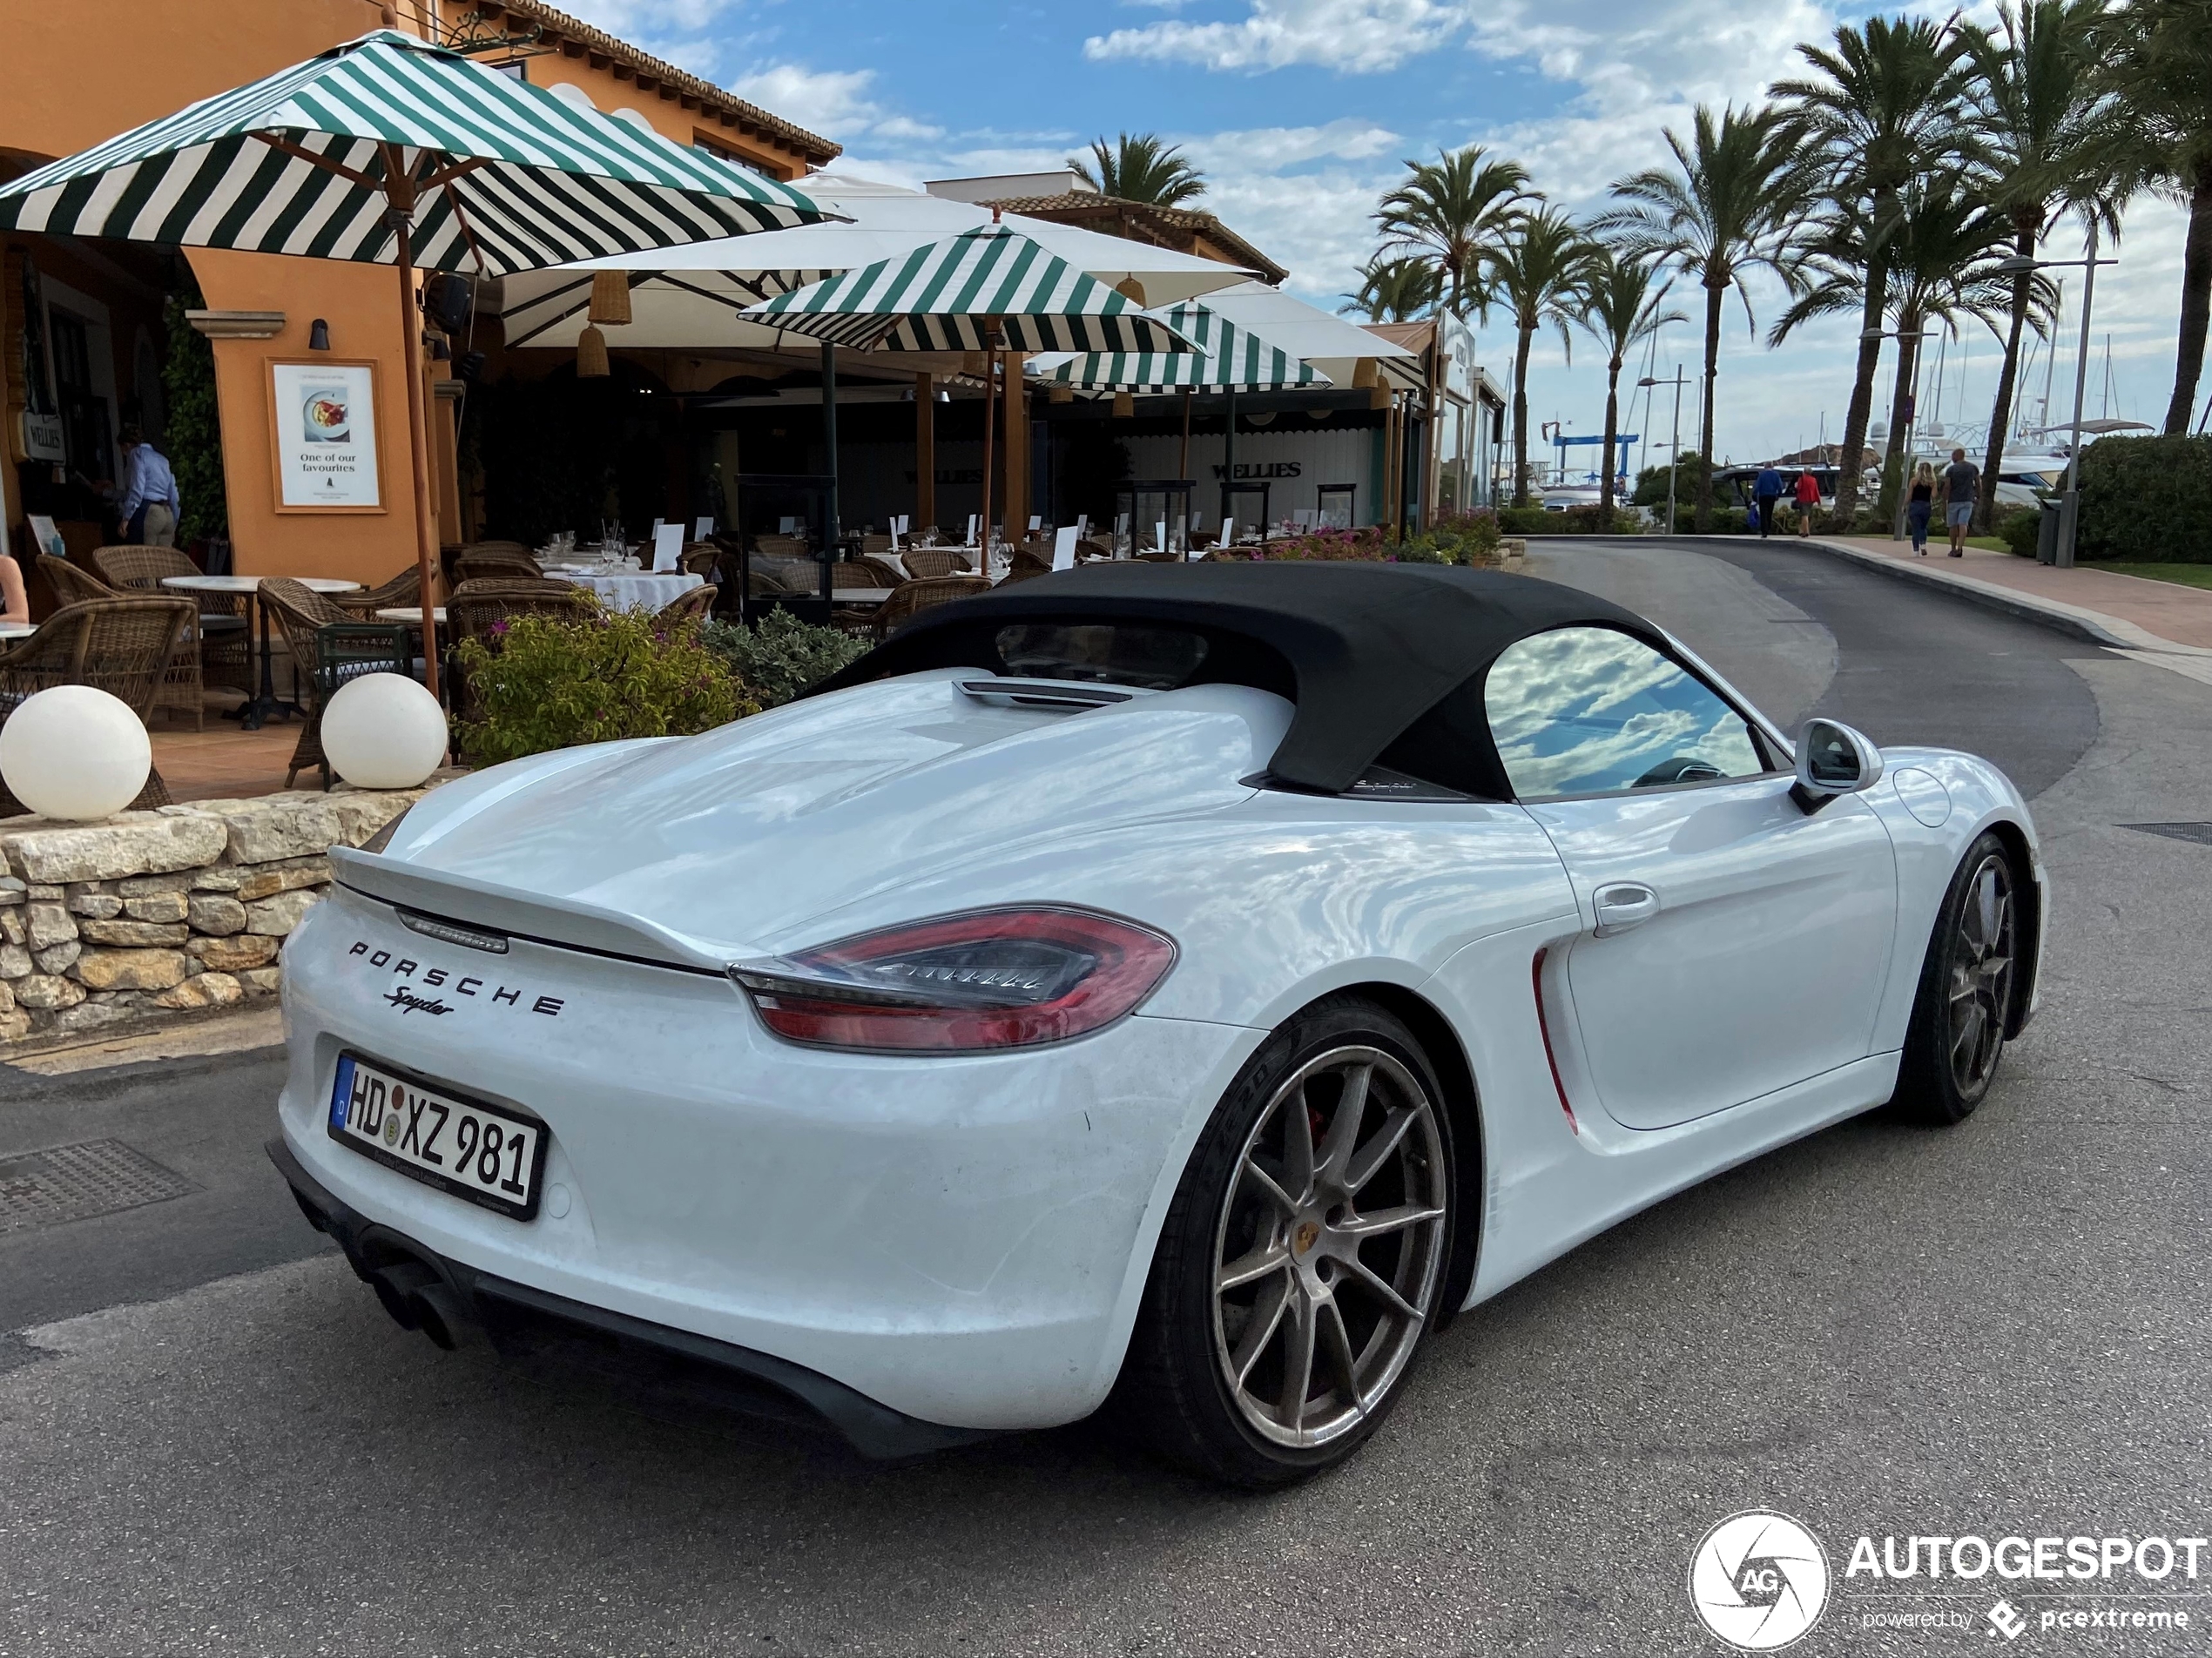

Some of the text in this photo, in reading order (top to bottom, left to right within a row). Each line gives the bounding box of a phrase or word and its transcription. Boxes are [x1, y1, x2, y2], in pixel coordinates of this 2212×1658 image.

[30, 425, 60, 448] WELLIES
[300, 453, 356, 462] One of our
[302, 463, 355, 473] favourites
[1211, 462, 1302, 480] WELLIES
[349, 940, 565, 1016] PORSCHE
[383, 986, 455, 1014] Spyder
[347, 1070, 526, 1196] HD XZ 981
